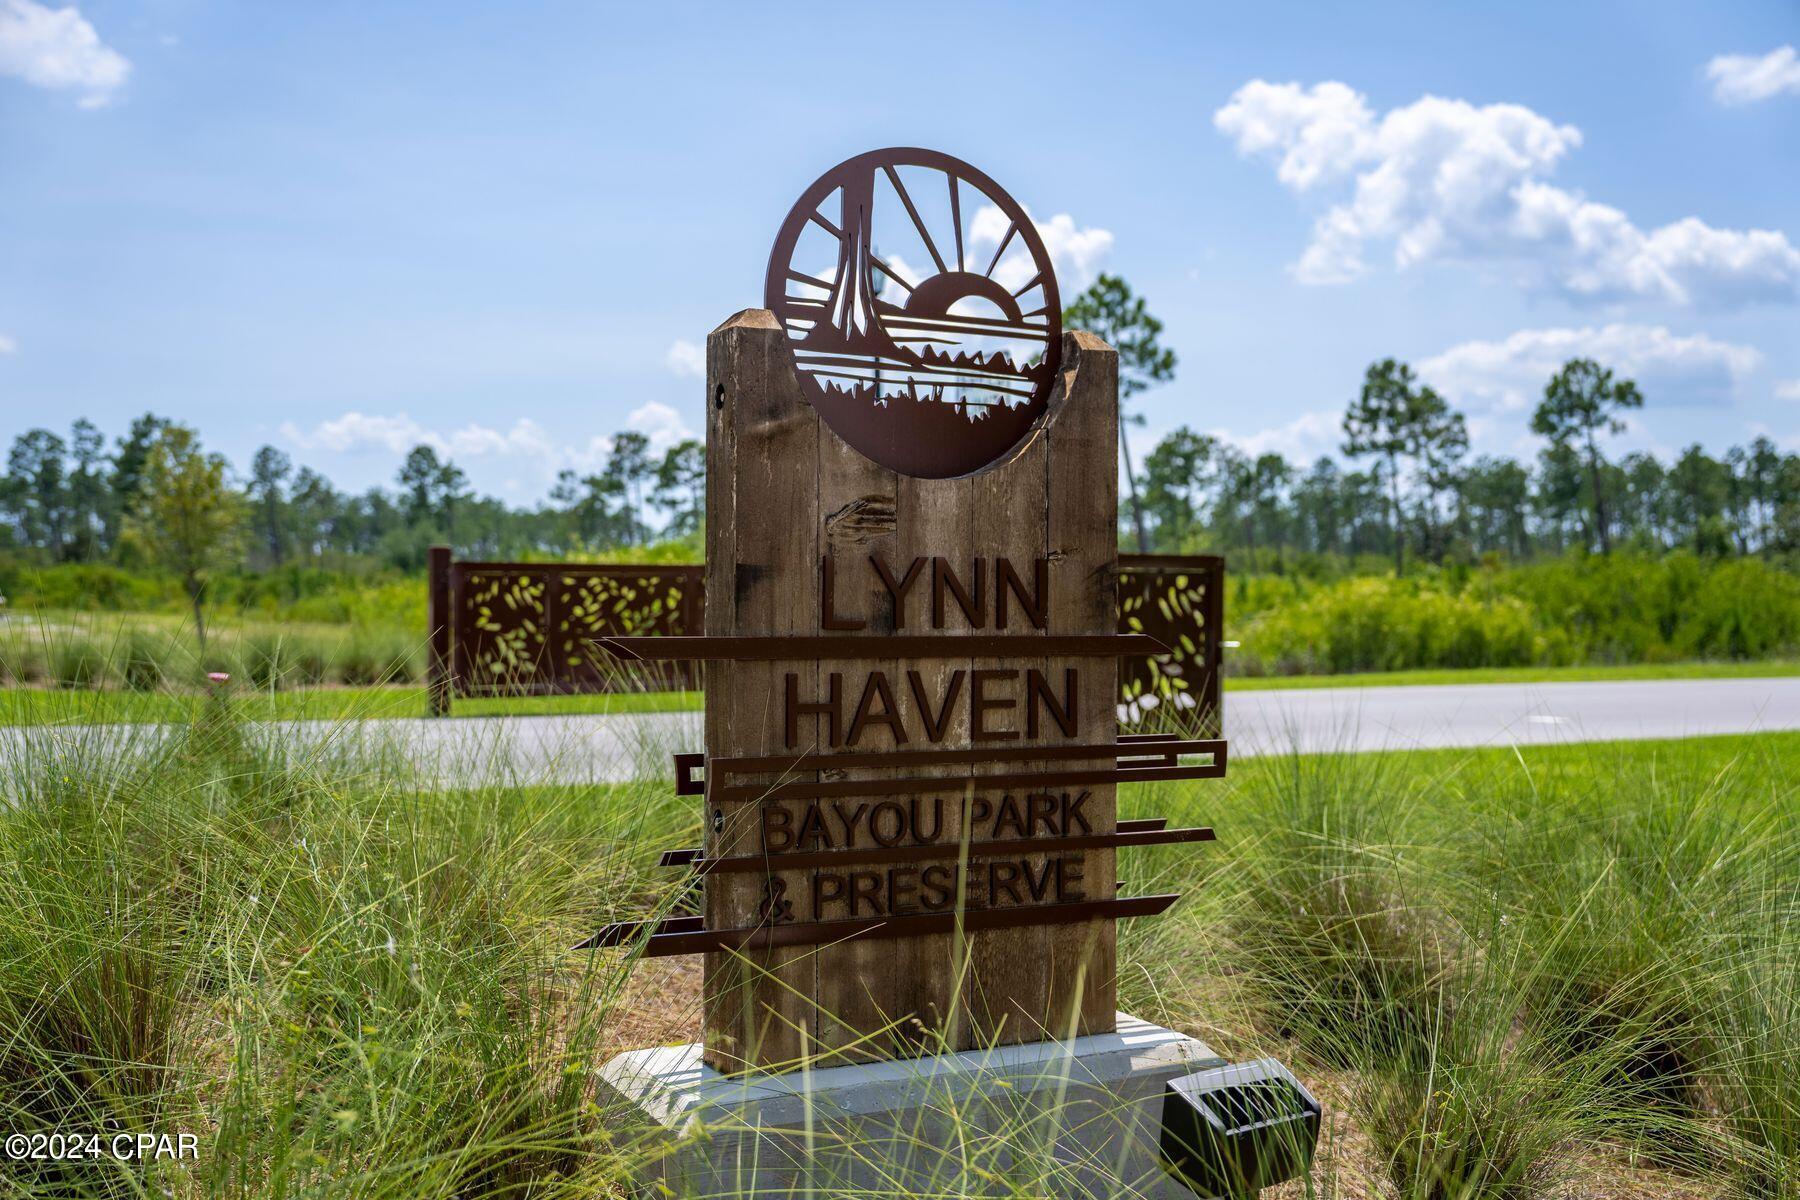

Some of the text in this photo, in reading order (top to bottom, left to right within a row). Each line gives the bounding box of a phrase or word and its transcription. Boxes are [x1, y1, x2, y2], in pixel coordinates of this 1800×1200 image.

[822, 555, 1048, 630] LYNN
[785, 668, 1078, 747] HAVEN
[762, 790, 1093, 851] BAYOU PARK
[759, 856, 1086, 922] & PRESERVE
